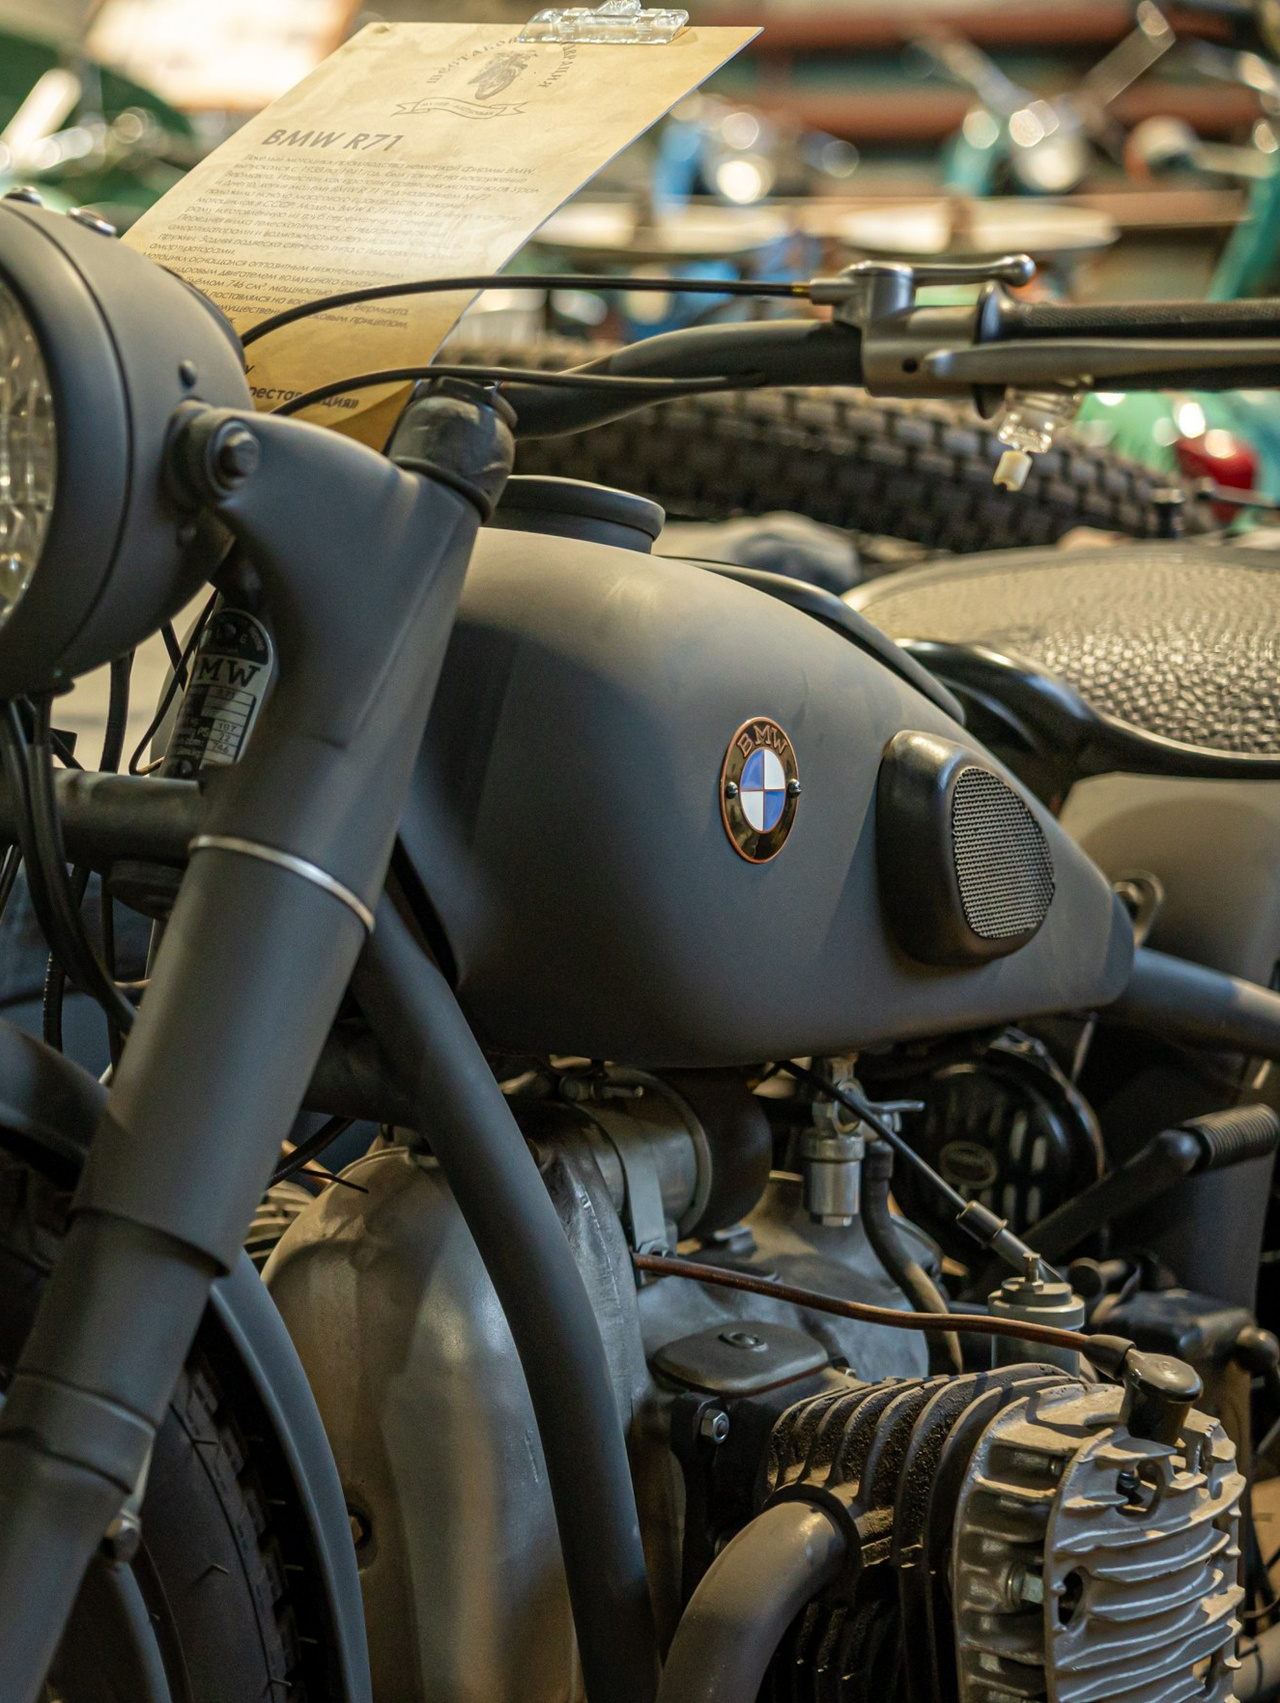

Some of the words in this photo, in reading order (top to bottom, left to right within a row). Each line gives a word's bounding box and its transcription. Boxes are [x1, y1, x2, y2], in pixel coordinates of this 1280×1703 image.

[261, 129, 346, 149] BMW
[343, 132, 405, 151] R71
[198, 658, 261, 688] MW
[737, 725, 788, 757] BMW
